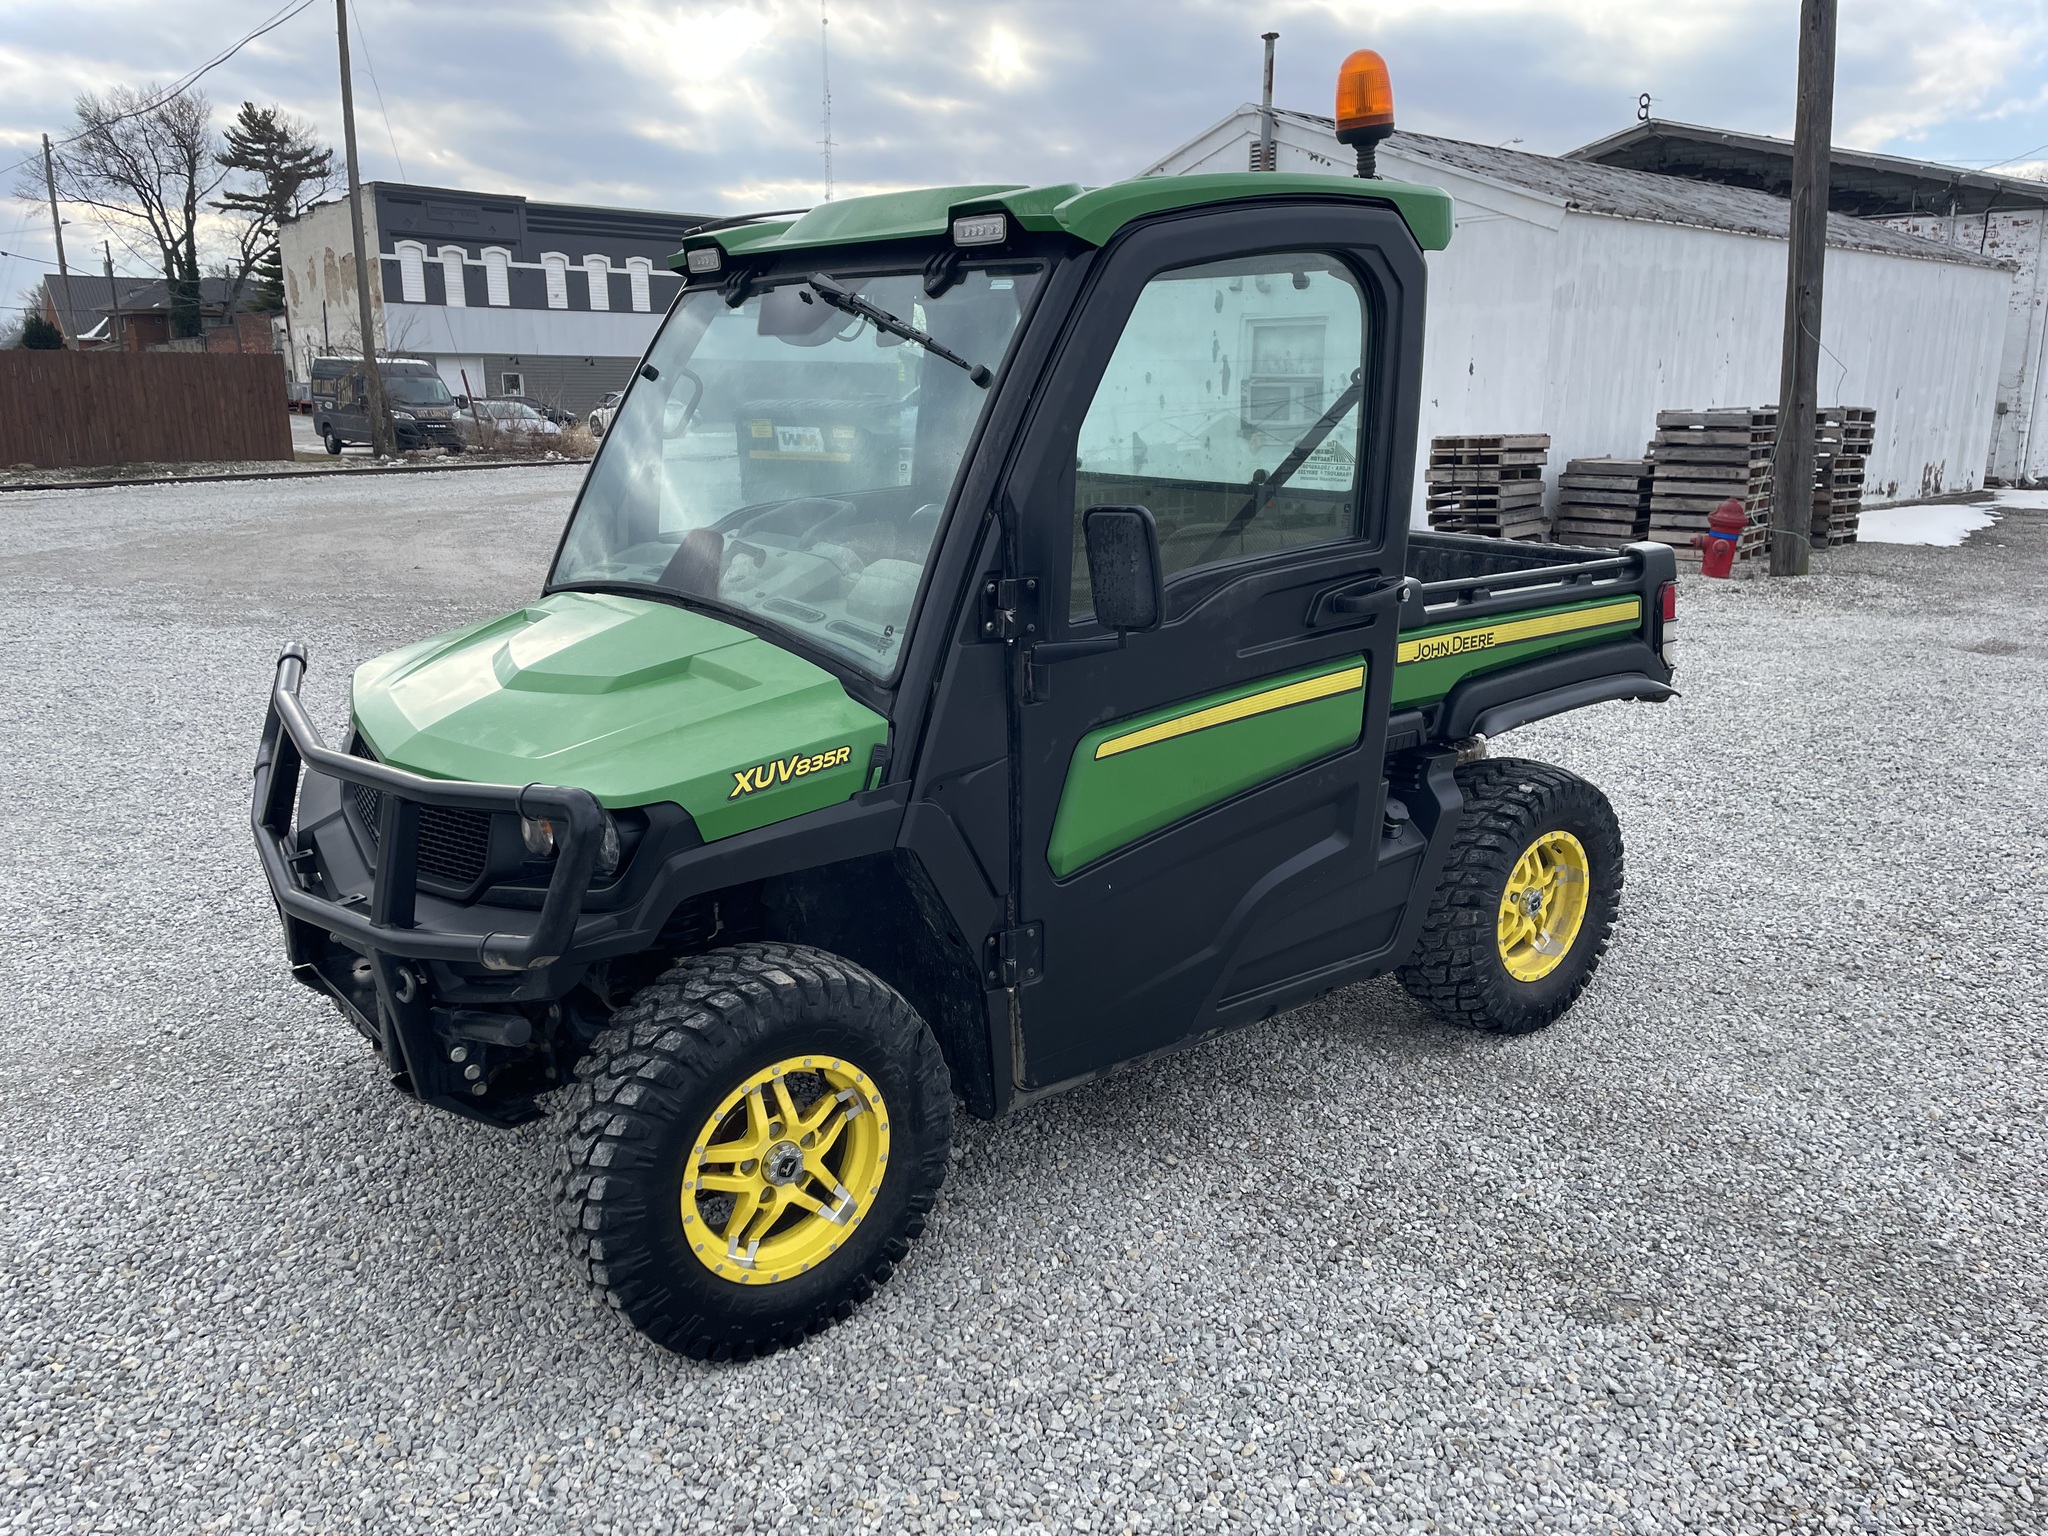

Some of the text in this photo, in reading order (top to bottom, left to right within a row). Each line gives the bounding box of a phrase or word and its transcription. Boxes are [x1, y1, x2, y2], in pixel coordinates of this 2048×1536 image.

[1413, 632, 1495, 661] JOHN DEERE
[728, 745, 852, 799] XUV835R
